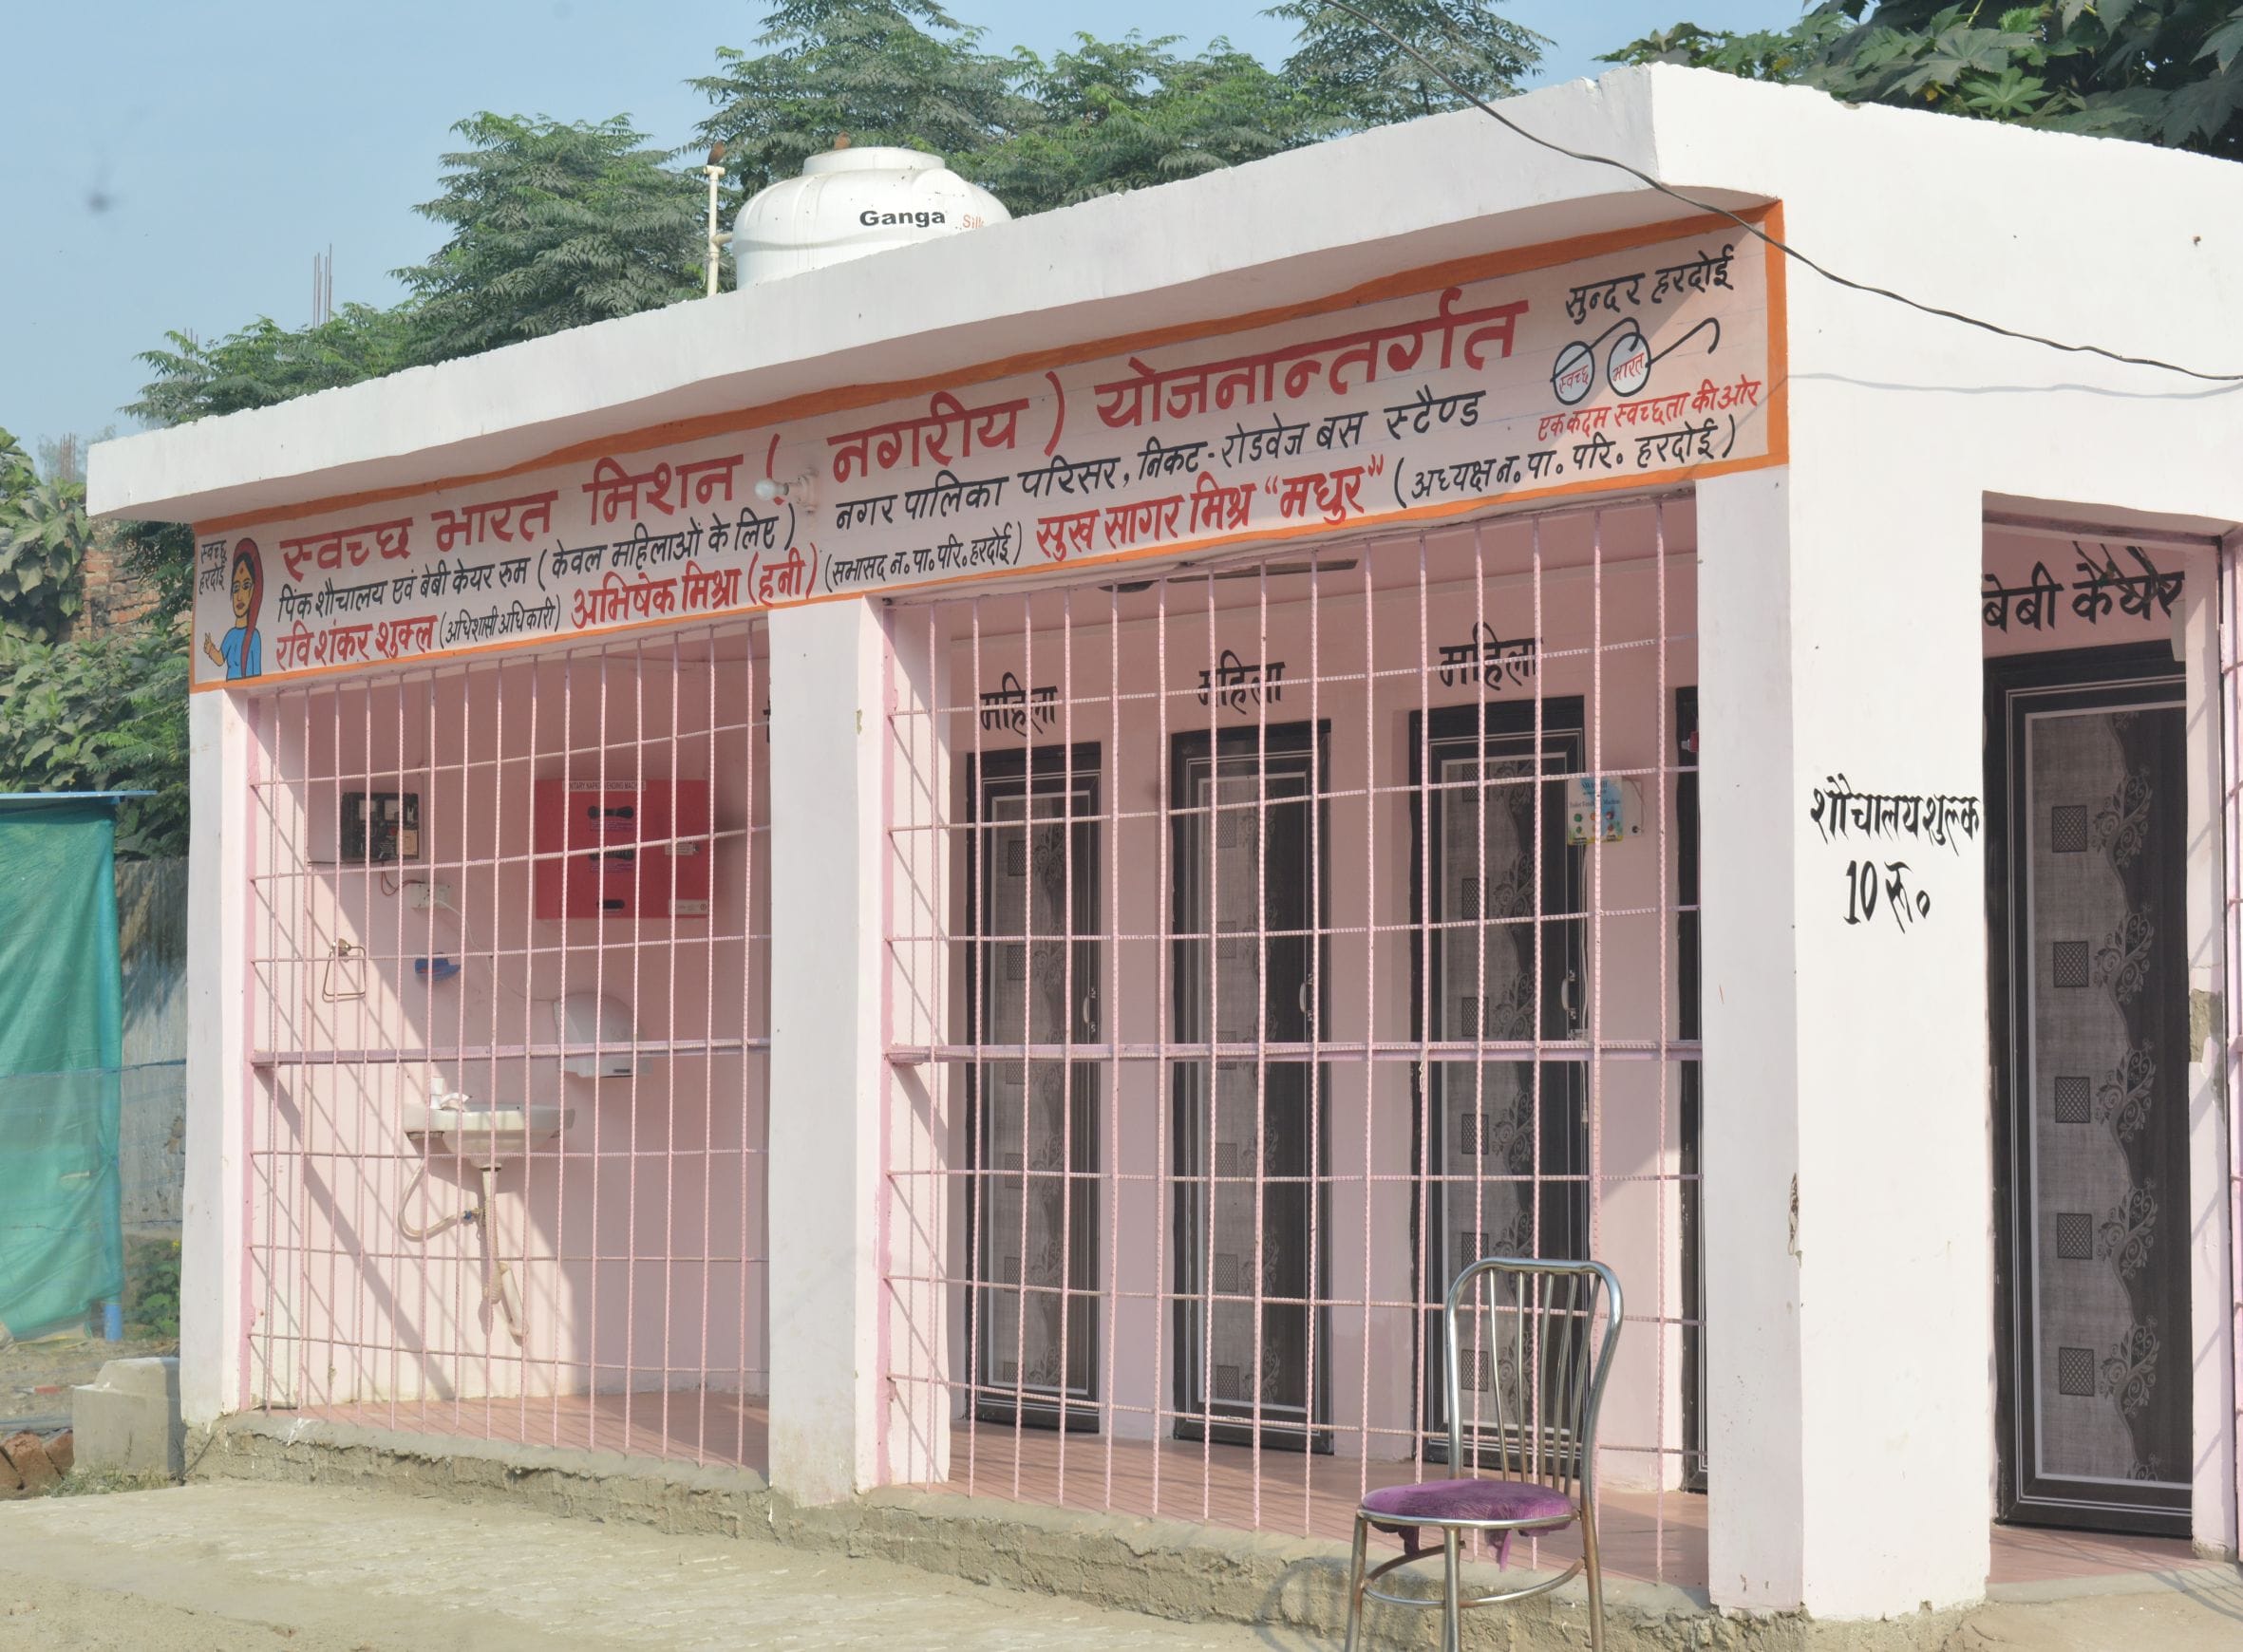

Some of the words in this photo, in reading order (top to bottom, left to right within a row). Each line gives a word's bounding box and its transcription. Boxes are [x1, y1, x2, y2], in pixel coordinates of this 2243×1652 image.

[858, 209, 947, 229] Ganga
[1564, 272, 1646, 326] सुन्दर
[1650, 244, 1735, 304] हरदोई
[1612, 351, 1646, 382] भारत
[279, 516, 414, 582] स्वच्छ
[430, 489, 559, 553] भारत
[581, 453, 745, 526] मिशन
[1093, 286, 1531, 428] योजनान्तर्गत
[1537, 412, 1566, 441] एक
[1566, 406, 1612, 437] कदम
[1613, 392, 1690, 426] स्वच्छता
[1690, 378, 1719, 415] की
[1717, 373, 1762, 407] ओर
[277, 583, 313, 623] पिंक
[315, 577, 388, 618] शौचालय
[392, 569, 418, 605] एवं
[420, 558, 452, 598] बेबी
[452, 558, 496, 594] केयर
[612, 516, 705, 572] महिलाओं
[708, 513, 731, 554] के
[835, 494, 898, 531] नगर
[904, 468, 1010, 521] पालिका
[1315, 410, 1369, 450] बस
[1383, 384, 1488, 441] स्टैण्ड
[374, 614, 439, 660] शुक्ल
[571, 571, 678, 630] अभिषेक
[680, 559, 743, 610] मिश्रा
[1189, 470, 1257, 534] मिश्र
[1981, 560, 2065, 633] बेबी
[1197, 648, 1287, 715] महिला
[1438, 621, 1544, 691] महिला
[978, 670, 1059, 738] महिला
[1843, 859, 1879, 926] 10
